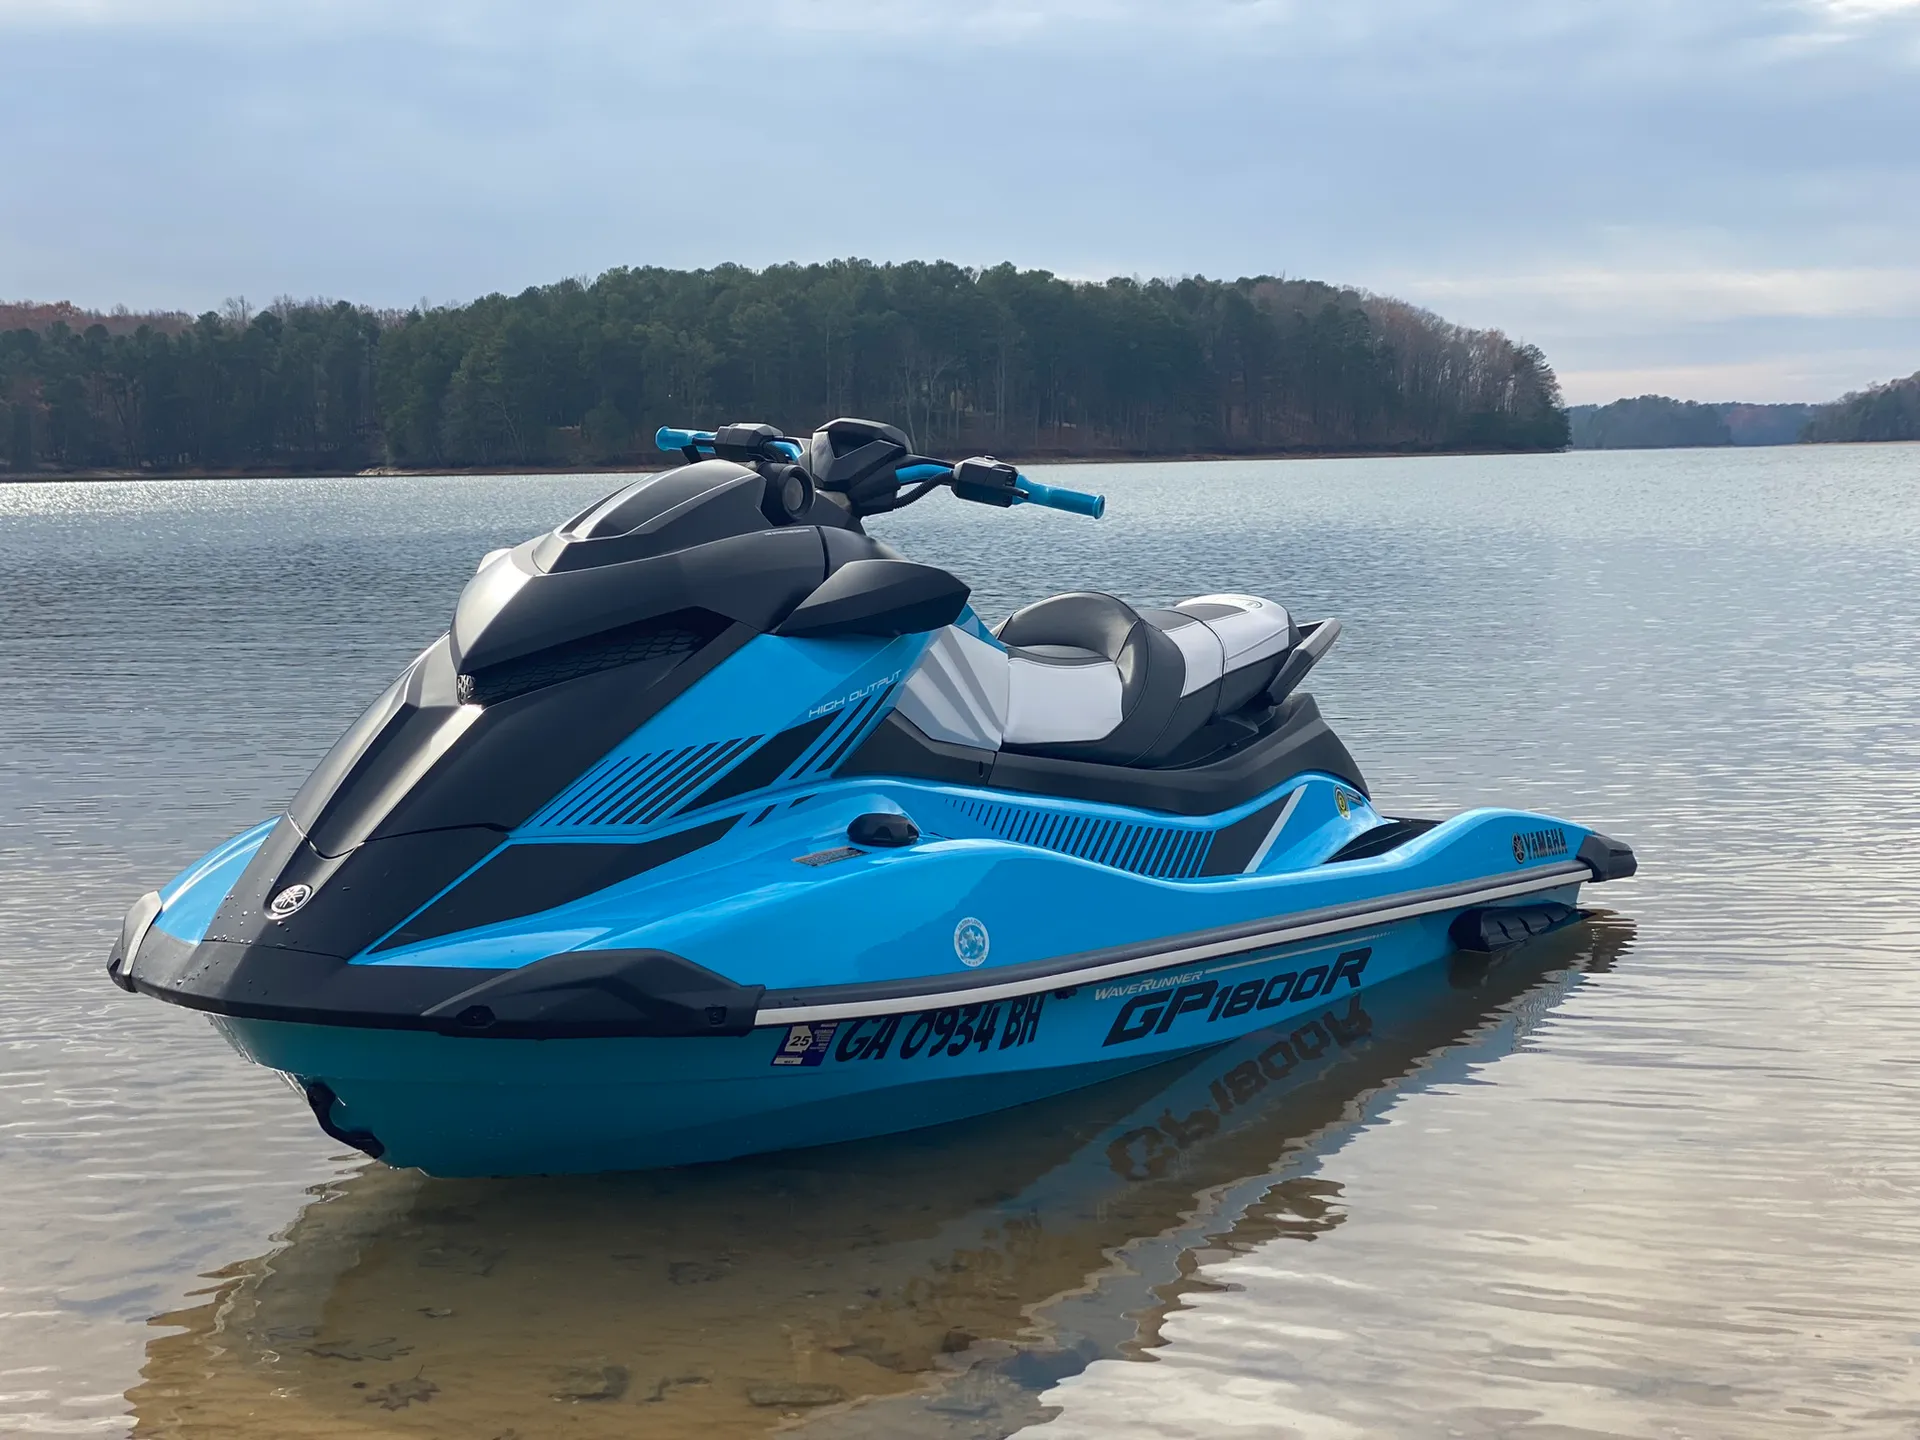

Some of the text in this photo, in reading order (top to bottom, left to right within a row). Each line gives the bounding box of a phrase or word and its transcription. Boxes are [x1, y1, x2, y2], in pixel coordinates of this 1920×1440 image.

[809, 669, 902, 718] HIGH OUTPUT
[1523, 828, 1568, 860] YAMAHA
[1102, 946, 1373, 1048] GP1800R
[789, 1035, 812, 1047] 25
[834, 994, 1046, 1062] GA 0934 BH
